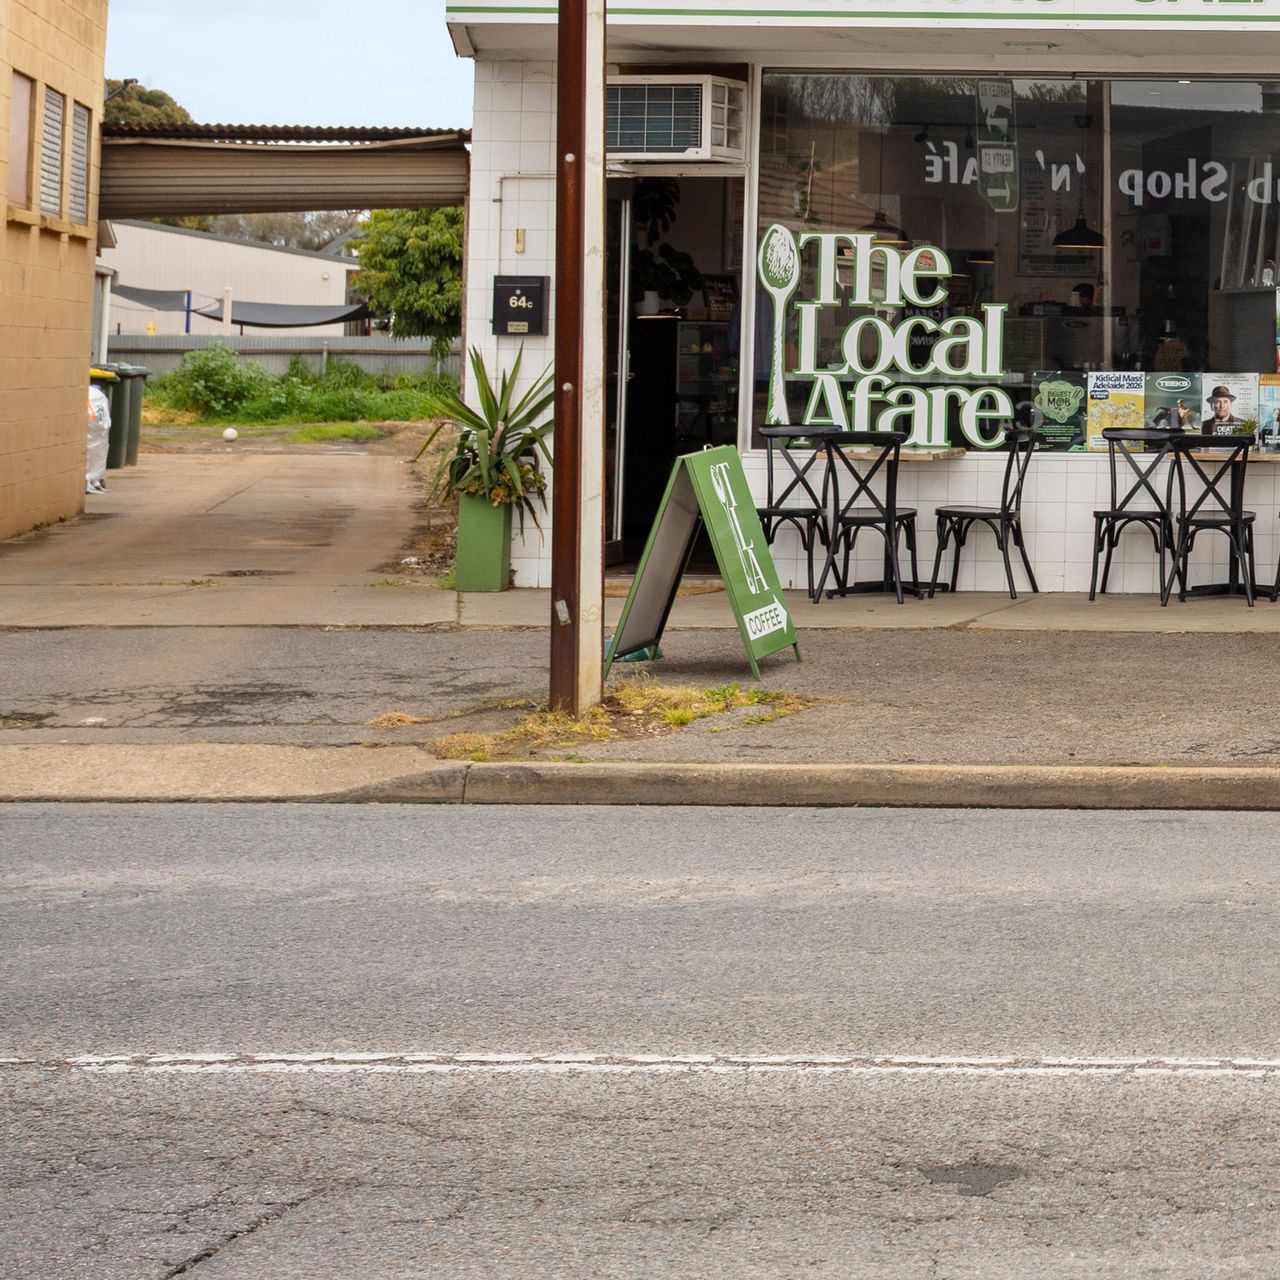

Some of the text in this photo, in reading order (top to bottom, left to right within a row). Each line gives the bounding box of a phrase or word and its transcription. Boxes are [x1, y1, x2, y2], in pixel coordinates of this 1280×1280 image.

[799, 230, 953, 307] The
[794, 302, 1009, 379] Local
[1093, 382, 1126, 390] Adelaide
[1123, 373, 1143, 382] Mass
[793, 373, 1015, 449] Afare
[748, 606, 783, 636] COFFEE
